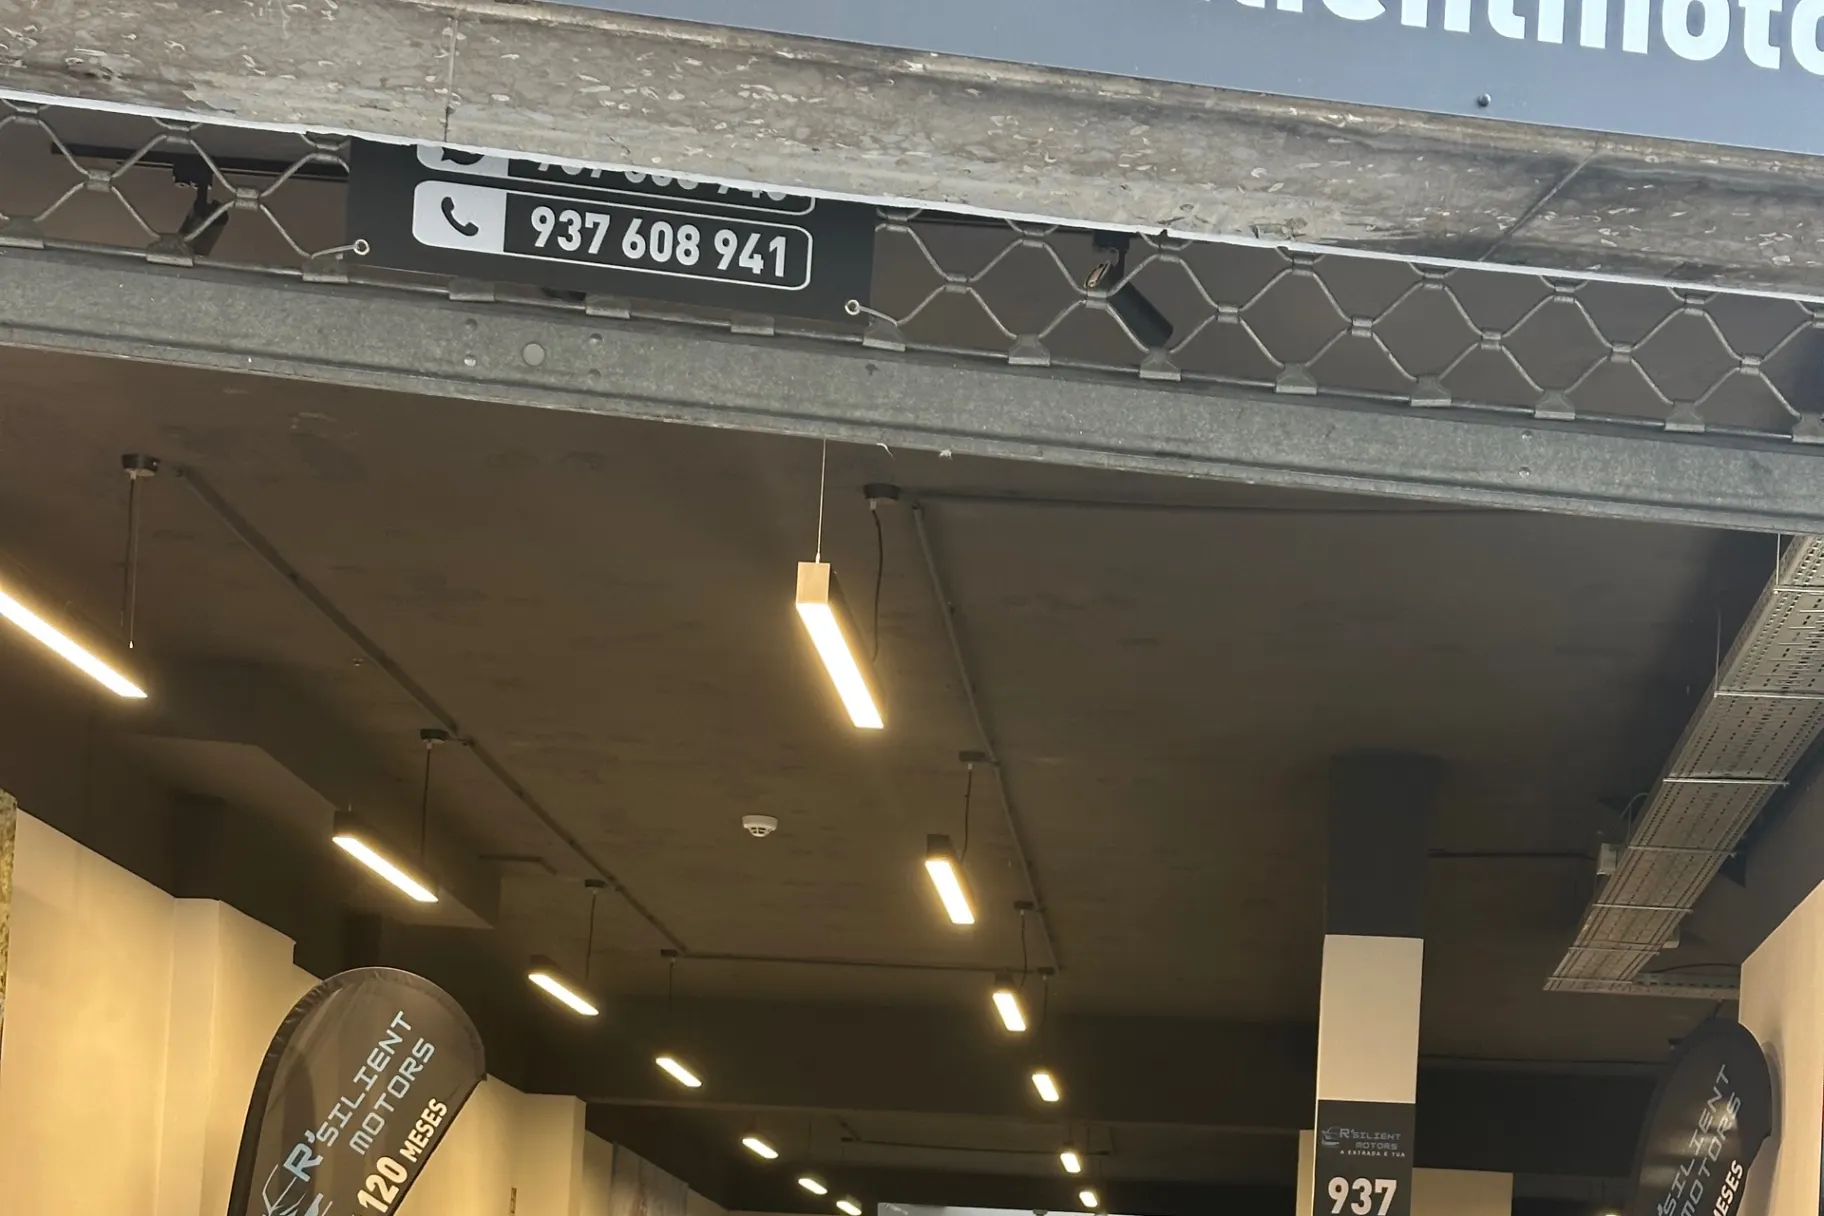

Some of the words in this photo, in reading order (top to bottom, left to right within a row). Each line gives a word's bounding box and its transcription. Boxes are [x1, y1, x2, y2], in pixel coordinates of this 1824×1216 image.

[530, 205, 611, 255] 937
[622, 217, 701, 267] 608
[714, 229, 787, 278] 941
[349, 1037, 435, 1155] MOTORS
[357, 1156, 408, 1213] 120
[399, 1098, 448, 1164] MESES
[1327, 1176, 1397, 1216] 937
